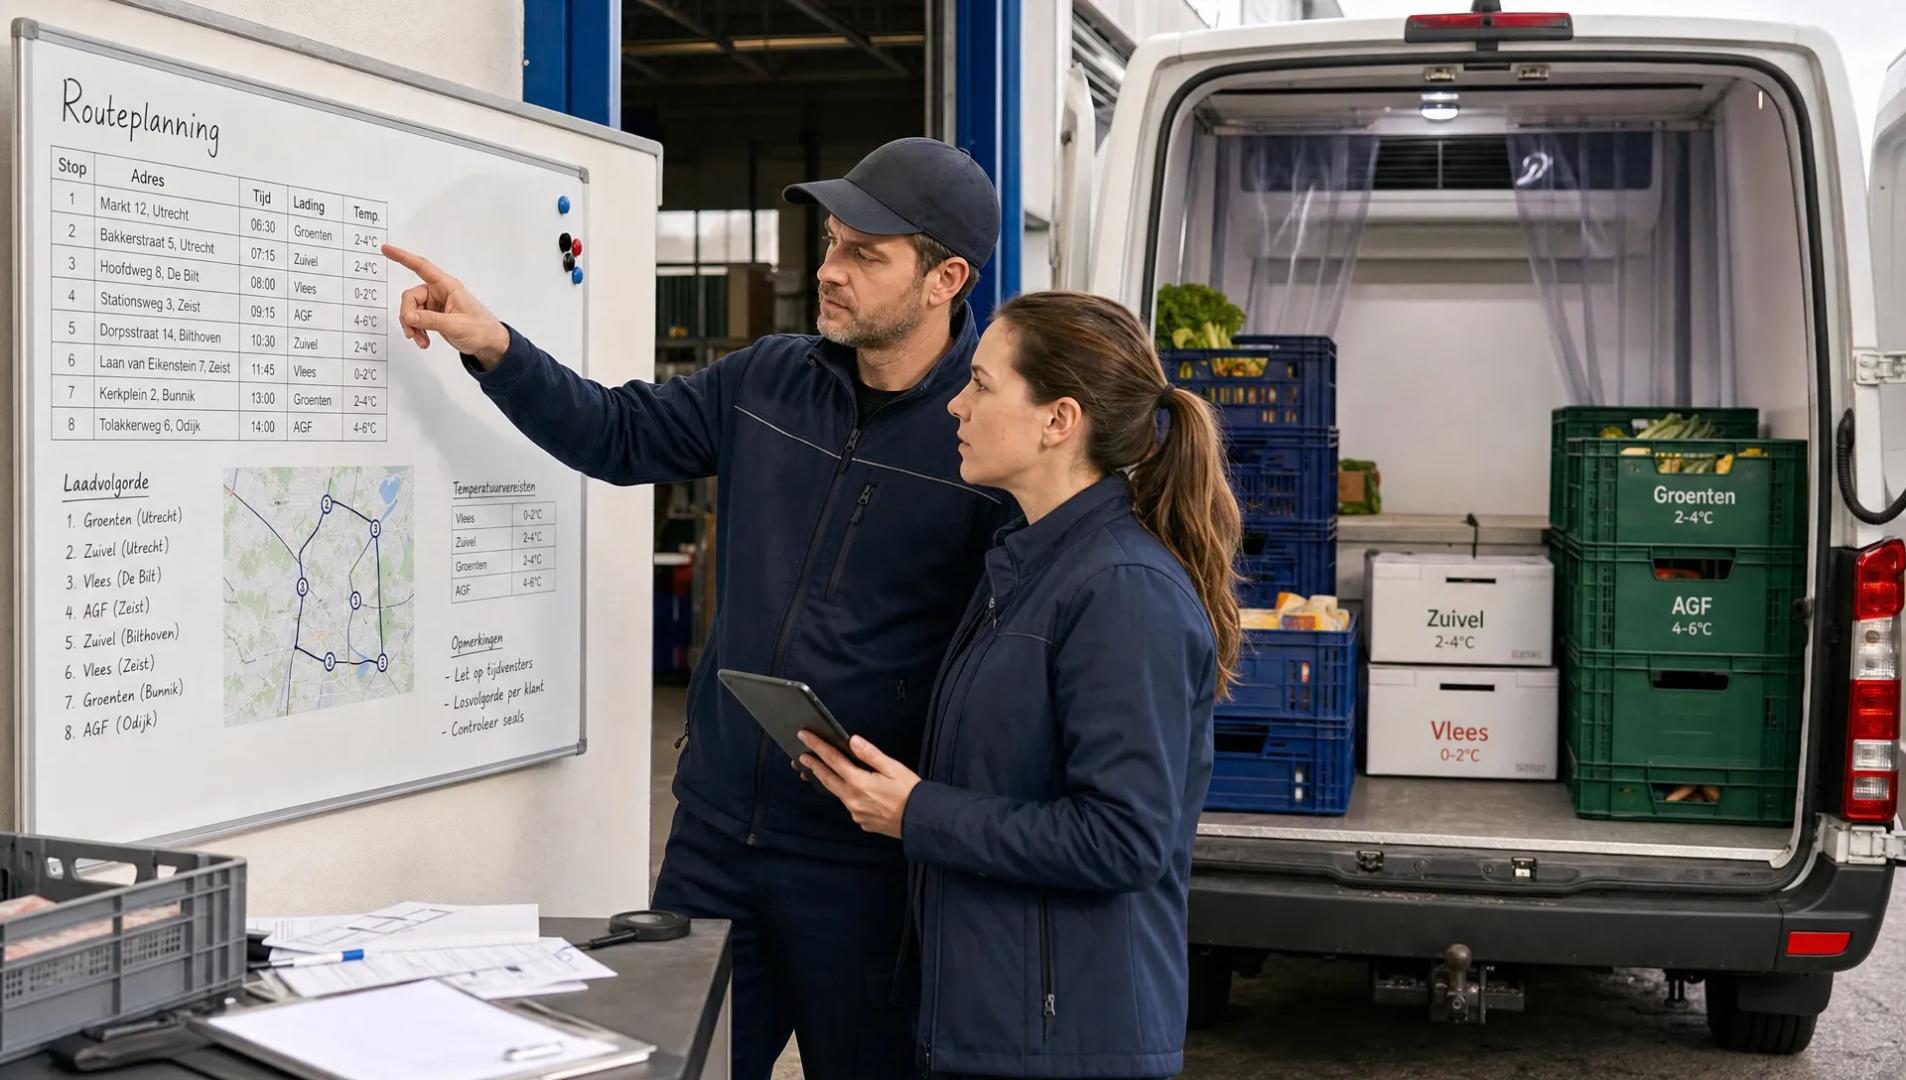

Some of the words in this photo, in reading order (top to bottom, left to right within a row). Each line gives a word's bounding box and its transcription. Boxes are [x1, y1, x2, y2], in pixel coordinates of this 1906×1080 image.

[63, 78, 220, 158] Routeplanning
[58, 158, 87, 178] Stop
[131, 169, 164, 187] Adres
[70, 192, 74, 205] 1
[253, 189, 270, 206] Tijd
[294, 196, 325, 215] Lading
[101, 196, 130, 213] Markt
[135, 202, 149, 217] 12,
[153, 204, 189, 221] Utrecht
[354, 206, 380, 224] Temp.
[68, 224, 76, 237] 2
[251, 218, 276, 233] 06:30
[294, 225, 332, 241] Groenten
[101, 228, 165, 248] Bakkerstraat
[168, 236, 176, 250] 5,
[180, 238, 214, 254] Utrecht
[251, 247, 275, 262] 07:15
[294, 253, 318, 267] Zuivel
[69, 257, 76, 270] 3
[101, 260, 152, 280] Hoofdweg
[156, 266, 164, 280] 8,
[168, 267, 181, 280] De
[184, 268, 200, 282] Bilt
[251, 276, 275, 290] 08:00
[294, 280, 316, 295] Vlees
[68, 290, 75, 302] 4
[101, 292, 163, 312] Stationsweg
[166, 299, 175, 312] 3,
[178, 299, 200, 312] Zeist
[251, 305, 275, 319] 09:15
[294, 309, 312, 321] AGF
[68, 321, 75, 335] 5
[101, 323, 158, 339] Dorpsstraat
[163, 328, 176, 341] 14,
[180, 329, 221, 343] Bilthoven
[252, 334, 275, 347] 10:30
[294, 337, 318, 350] Zuivel
[68, 353, 75, 367] 6
[100, 355, 124, 369] Laan
[128, 359, 145, 370] van
[148, 357, 196, 372] Eikenstein
[199, 360, 206, 374] 7,
[209, 360, 230, 373] Zeist
[252, 363, 274, 376] 11:45
[294, 365, 316, 378] Vlees
[68, 386, 75, 398] 7
[100, 386, 147, 403] Kerkplein
[150, 389, 159, 403] 2,
[163, 389, 195, 401] Bunnik
[252, 392, 275, 405] 13:00
[294, 393, 332, 406] Groenten
[68, 417, 75, 431] 8
[100, 418, 161, 434] Tolakkerweg
[164, 419, 173, 433] 6,
[176, 419, 200, 434] Odijk
[251, 420, 275, 433] 14:00
[294, 421, 312, 433] AGF
[64, 472, 149, 498] Laadvolgorde
[453, 480, 536, 498] Temperatuurvereisten
[1654, 485, 1735, 505] Groenten
[84, 512, 132, 528] Groenten
[137, 506, 182, 527] (Utrecht)
[1674, 511, 1713, 524] 2-4°C
[66, 545, 77, 560] 2.
[84, 542, 116, 558] Zuivel
[122, 536, 169, 558] (Utrecht)
[84, 573, 111, 588] Vlees
[117, 569, 134, 588] (De
[140, 566, 161, 584] Bilt)
[456, 584, 471, 596] AGF
[84, 602, 108, 619] AGF
[113, 596, 150, 618] (Zeist)
[1672, 596, 1712, 615] AGF
[1427, 609, 1484, 628] Zuivel
[65, 636, 76, 650] 5.
[83, 632, 116, 648] Zuivel
[121, 622, 179, 647] (Bilthoven)
[1672, 622, 1712, 636] 4-6°C
[451, 632, 503, 654] Opmerkingen
[1435, 635, 1474, 649] 2-4°C
[65, 665, 76, 679] 6.
[83, 662, 112, 677] Vlees
[118, 654, 154, 676] (Zeist)
[455, 667, 469, 682] Let
[474, 669, 483, 683] op
[487, 658, 533, 680] tijdvensters
[83, 690, 134, 707] Groenten
[140, 678, 183, 702] (Bunnik)
[454, 687, 504, 710] Losvolgorde
[508, 687, 521, 704] per
[524, 680, 544, 695] klant
[65, 725, 76, 740] 8.
[83, 720, 108, 737] AGF
[116, 710, 157, 734] (Odijk)
[452, 716, 499, 736] Controleer
[503, 709, 524, 726] seals
[1431, 720, 1488, 741] Vlees
[1440, 749, 1480, 762] 0-2°C
